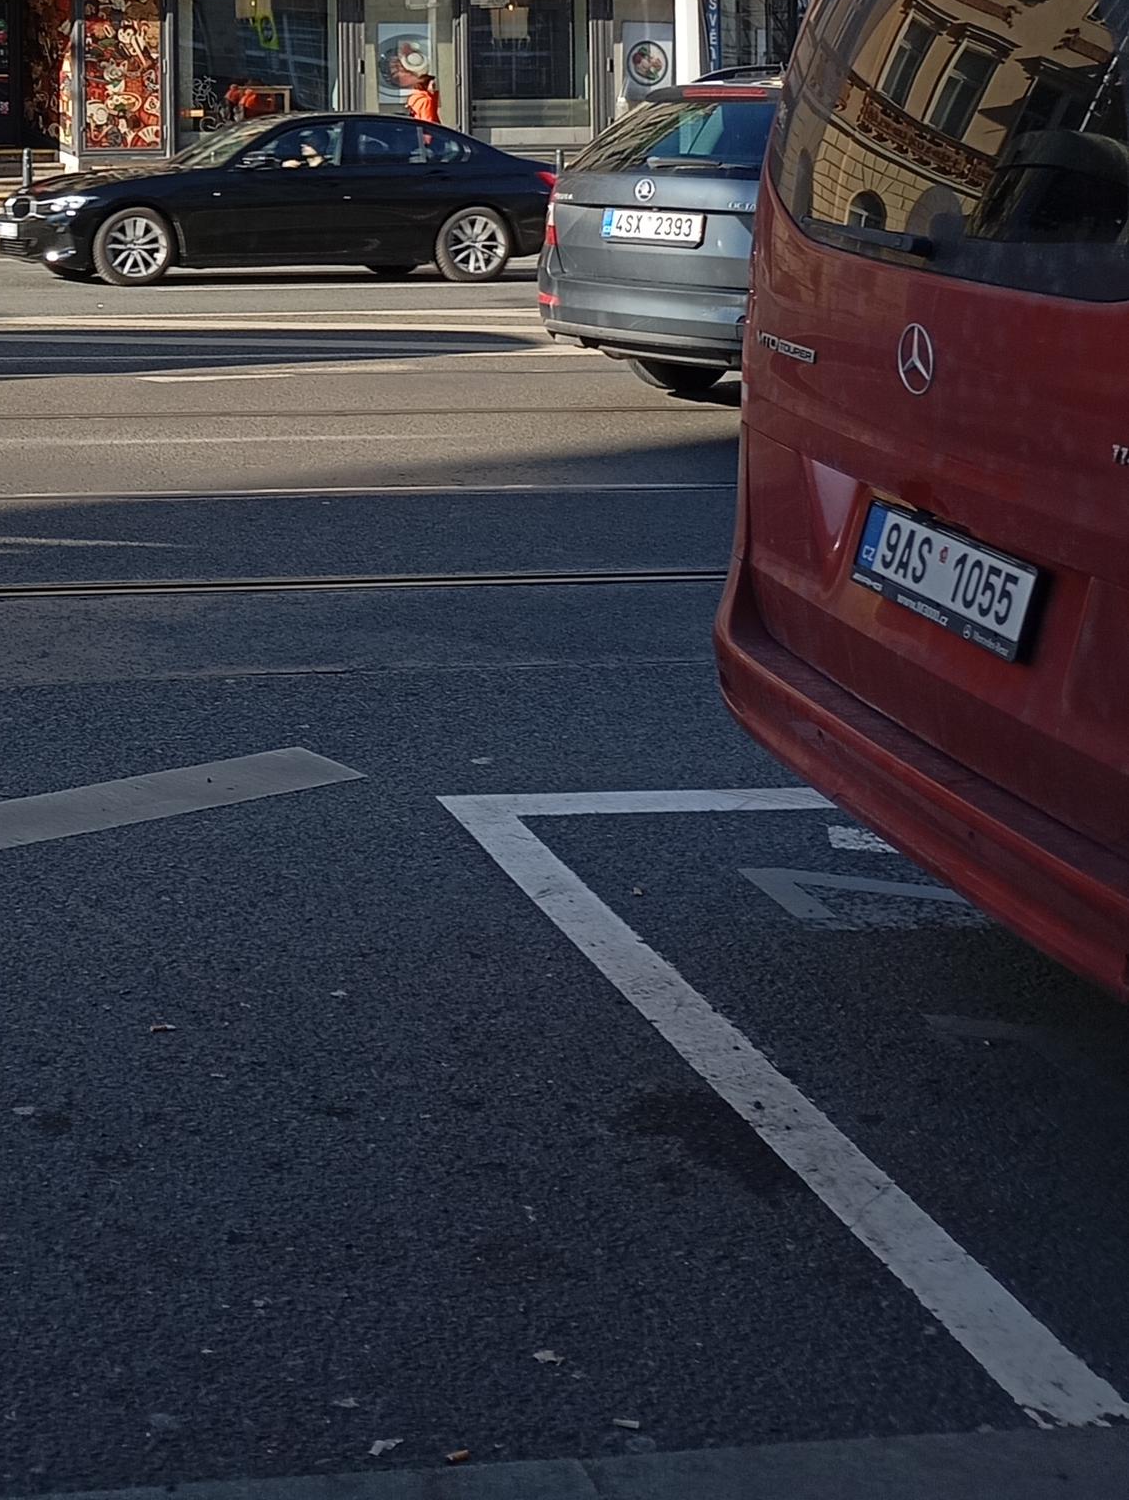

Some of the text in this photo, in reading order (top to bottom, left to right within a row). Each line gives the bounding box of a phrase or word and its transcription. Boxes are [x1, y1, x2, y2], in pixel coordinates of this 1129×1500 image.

[615, 214, 693, 237] 4SX 2393
[862, 546, 875, 562] CZ
[881, 522, 932, 584] 9AS
[950, 553, 1019, 626] 1055
